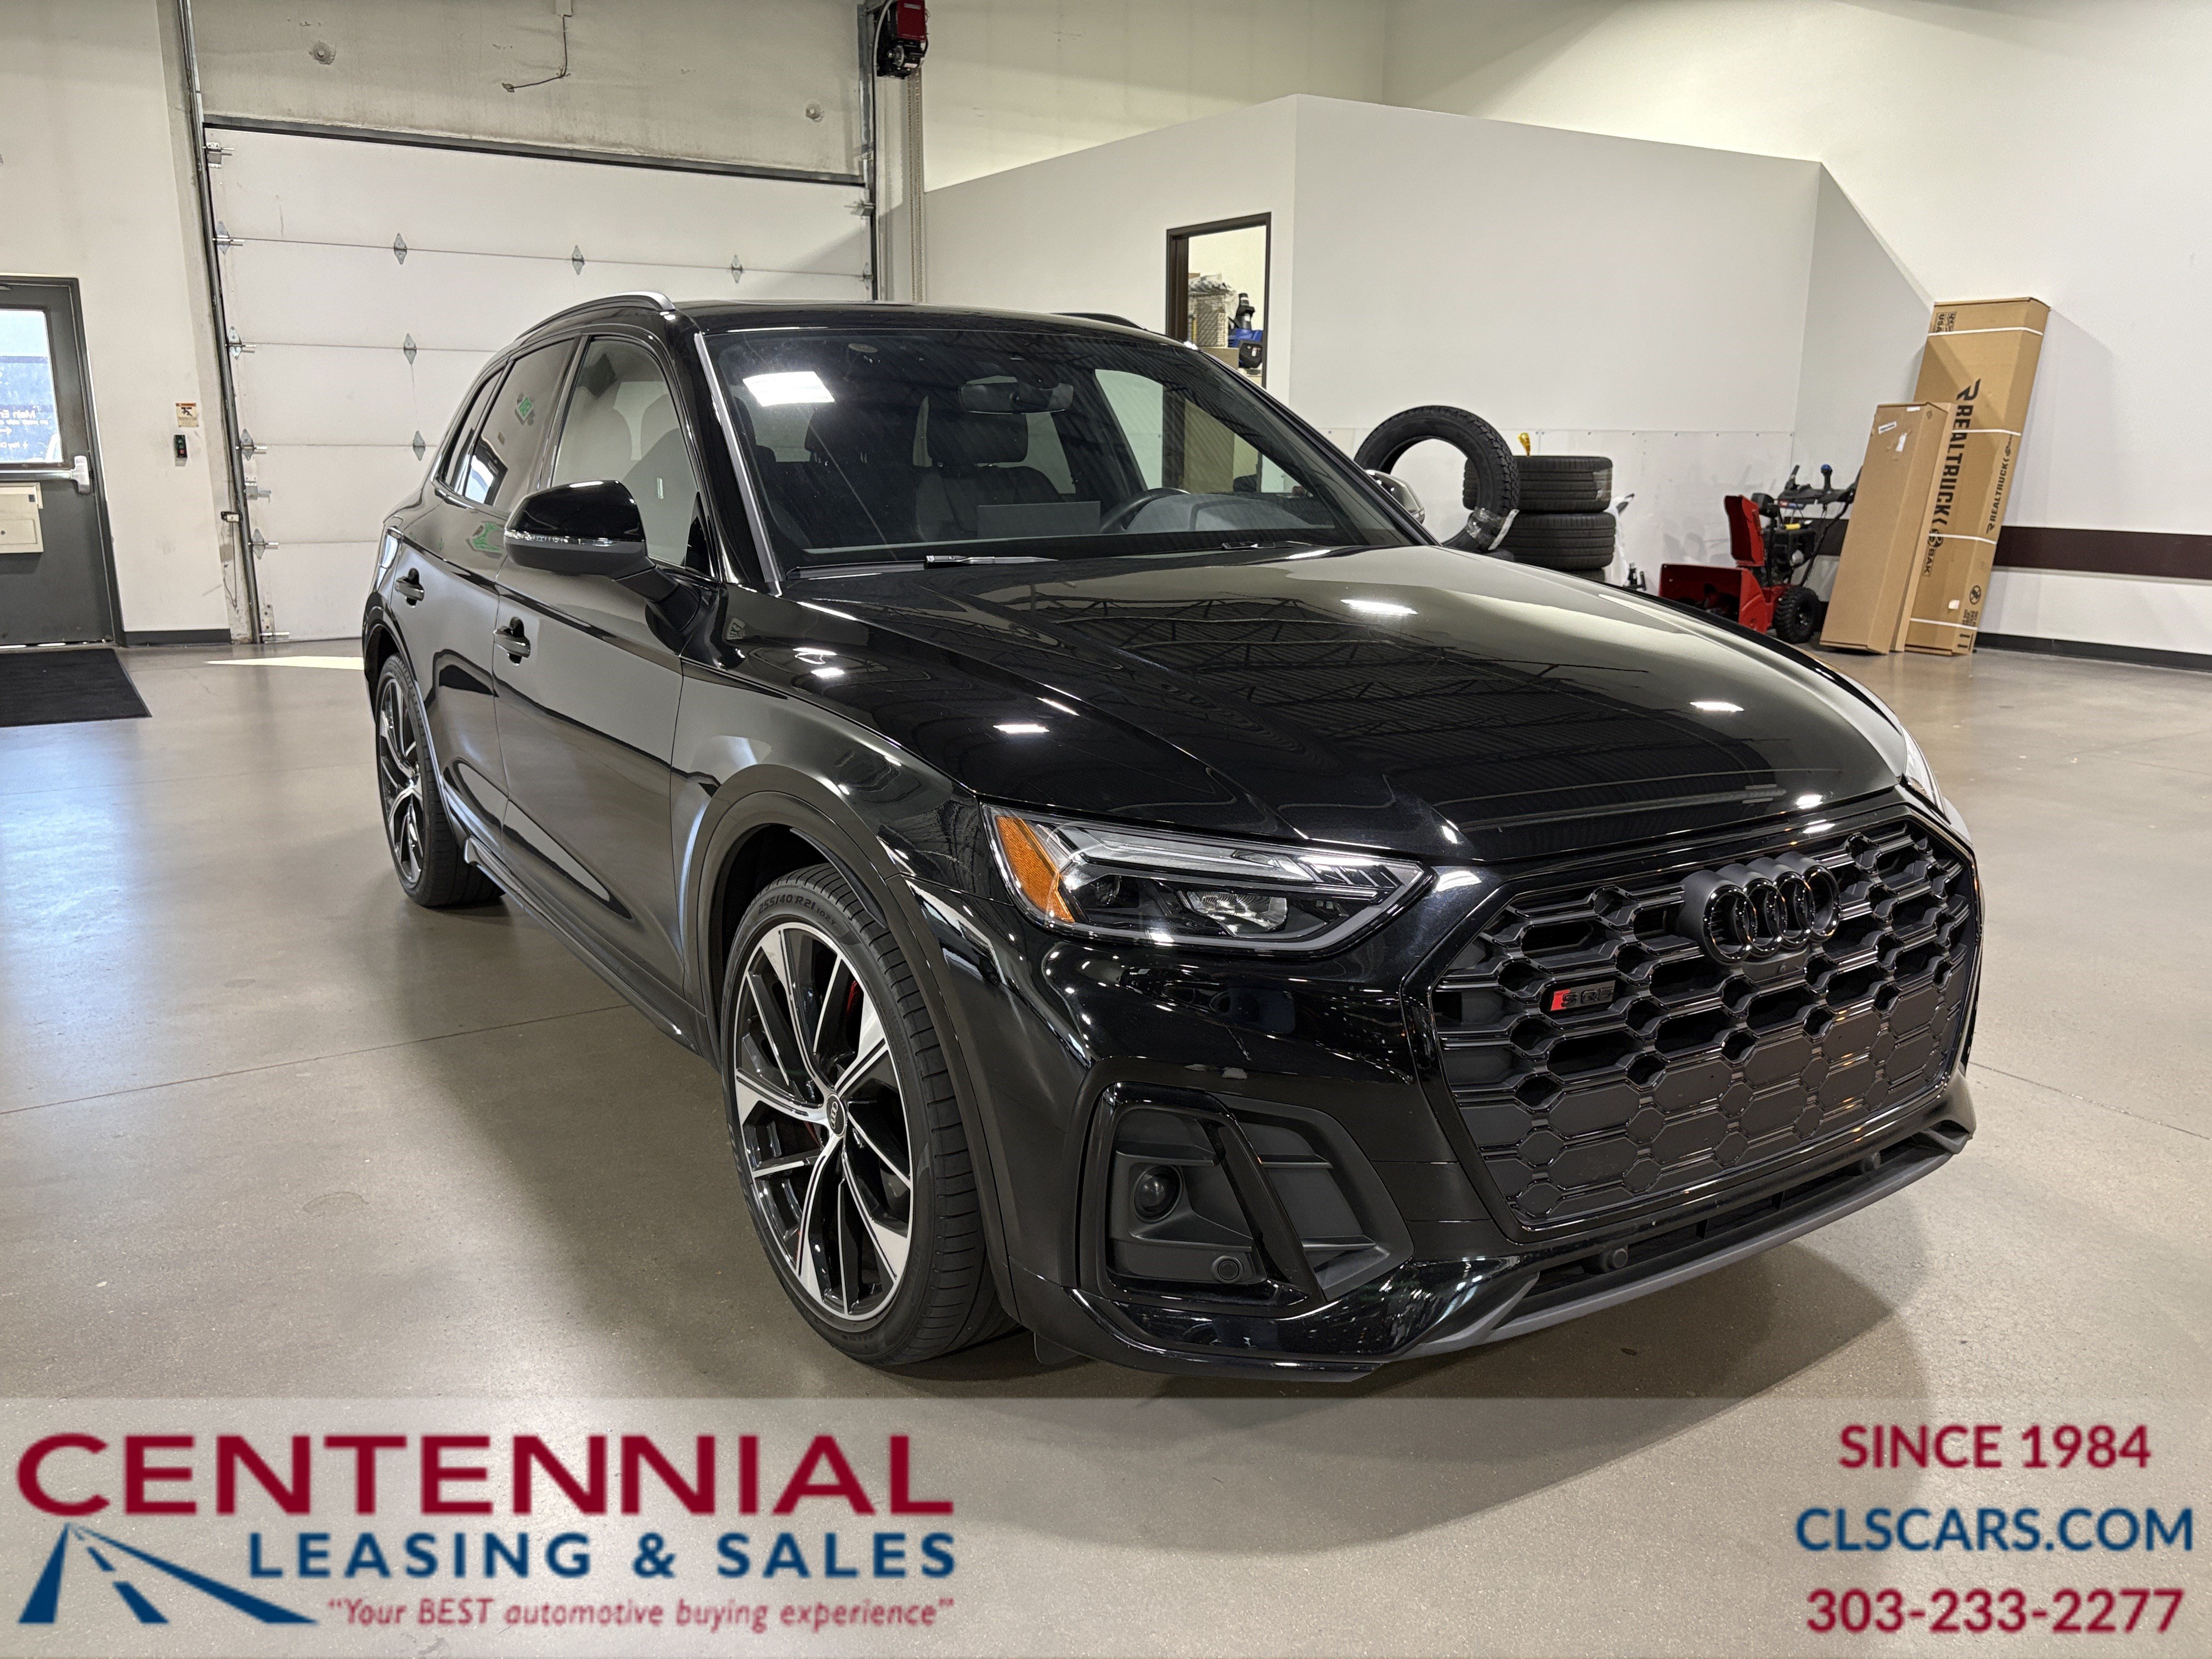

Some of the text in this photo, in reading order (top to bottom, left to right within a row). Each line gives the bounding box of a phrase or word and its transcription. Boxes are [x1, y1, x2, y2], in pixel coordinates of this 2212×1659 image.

[1934, 405, 1974, 517] REALTRUCK
[758, 894, 837, 926] 255/40 R21 102Y
[1558, 985, 1614, 1008] SQ5
